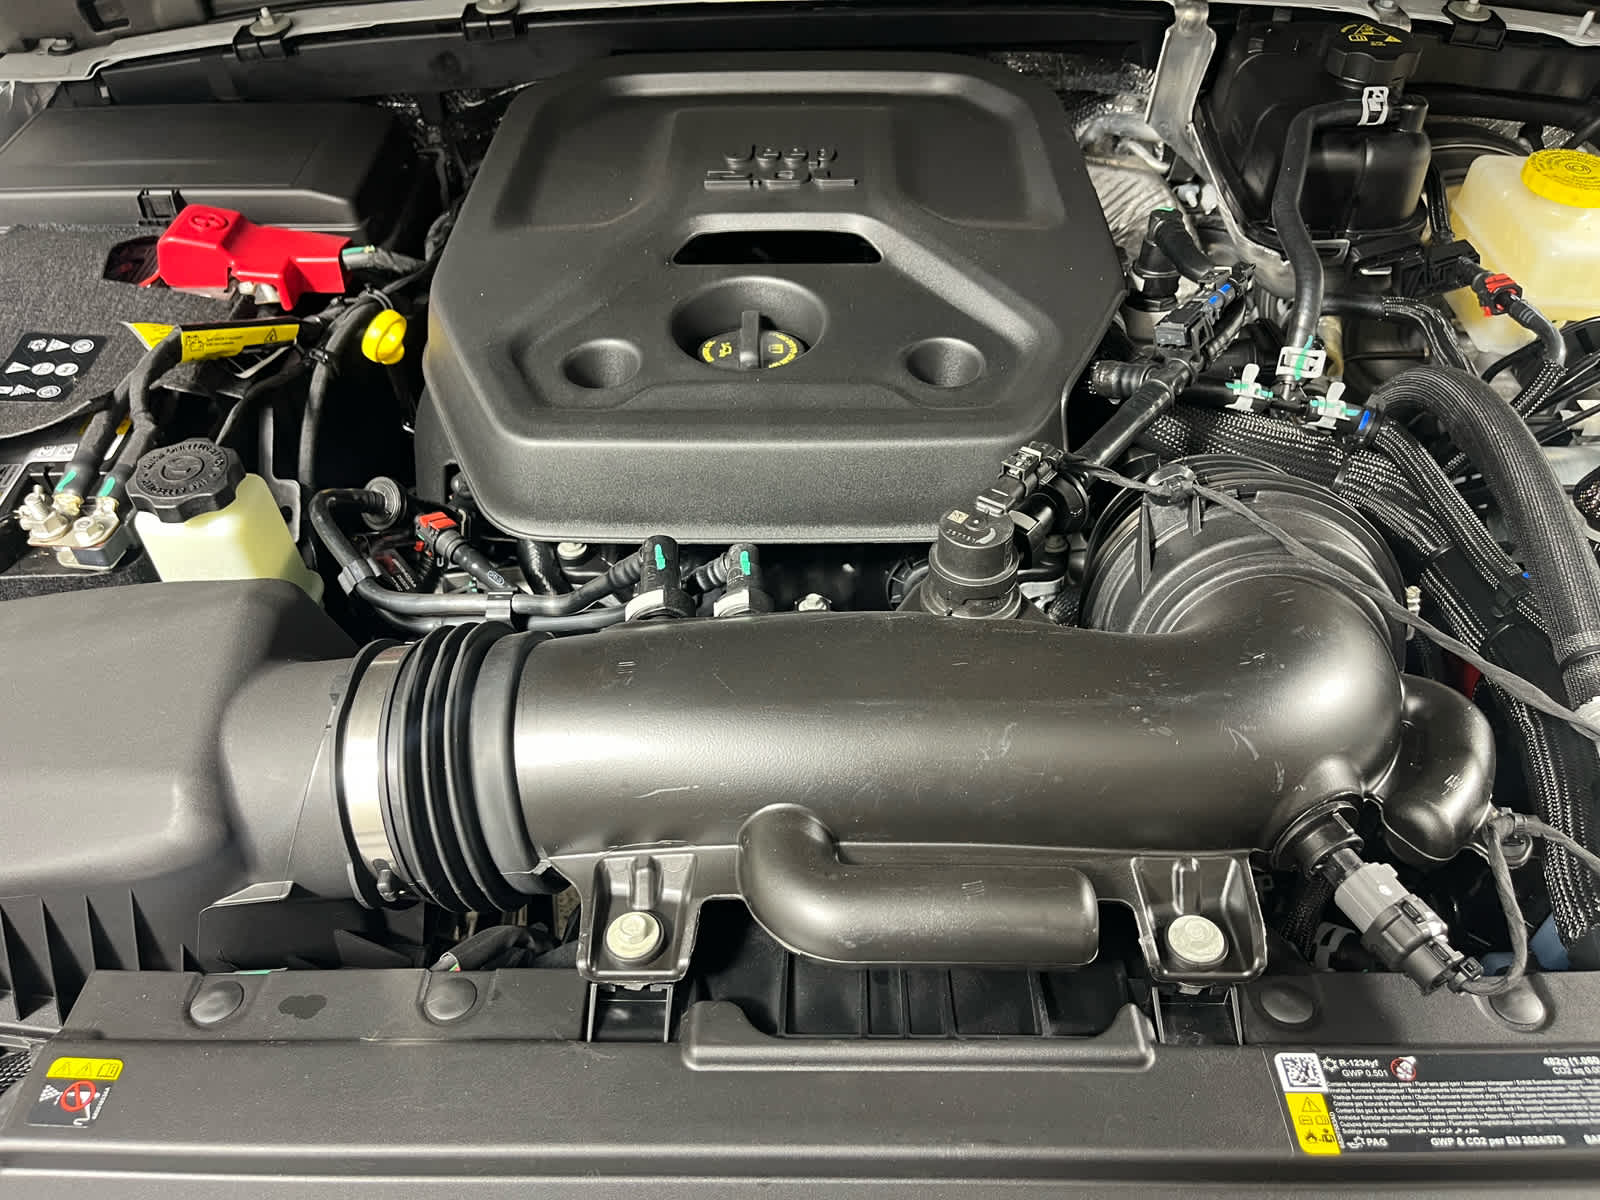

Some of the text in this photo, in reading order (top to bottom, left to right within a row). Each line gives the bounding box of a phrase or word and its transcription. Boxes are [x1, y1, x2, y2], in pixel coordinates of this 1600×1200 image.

[722, 144, 838, 170] Jeep
[1341, 1069, 1389, 1077] GWP 0.501
[1552, 1066, 1573, 1075] CO2
[1365, 1137, 1388, 1147] PAG
[1430, 1137, 1455, 1147] GWP
[1456, 1137, 1465, 1146] &
[1465, 1136, 1488, 1146] CO2
[1488, 1137, 1505, 1148] per
[1505, 1136, 1522, 1145] EU
